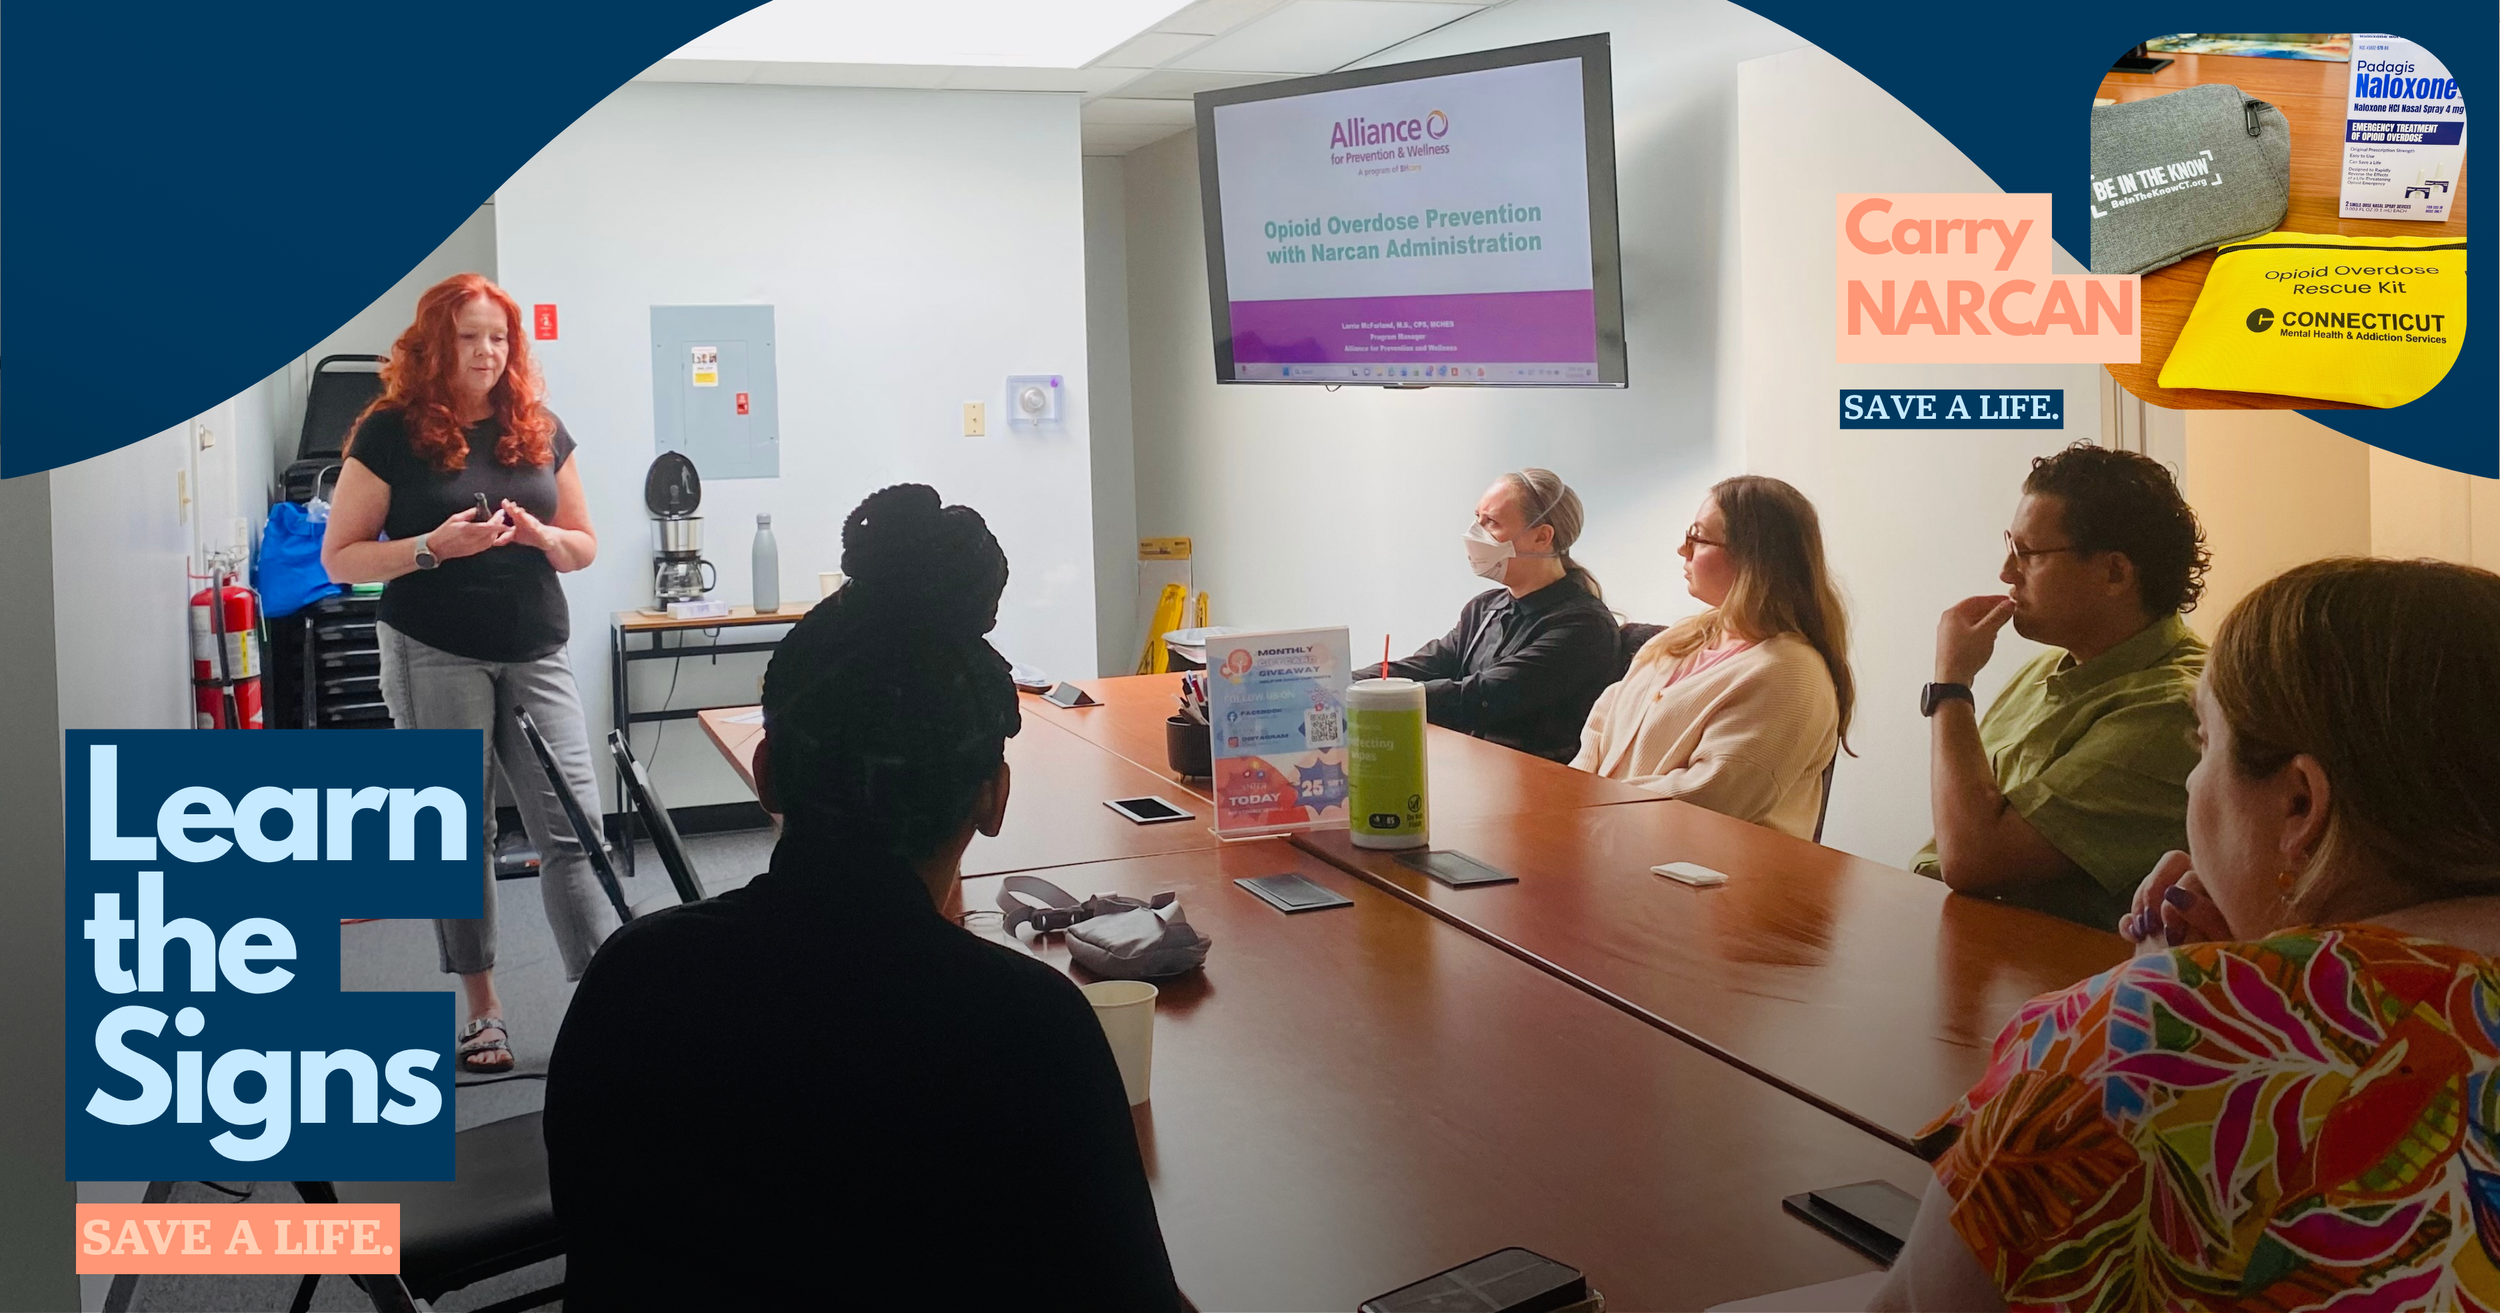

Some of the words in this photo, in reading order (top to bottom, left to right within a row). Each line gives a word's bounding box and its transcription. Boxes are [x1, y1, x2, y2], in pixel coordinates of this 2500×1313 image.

[2357, 60, 2415, 76] Padagis
[2355, 73, 2458, 100] Naloxone
[2354, 103, 2386, 112] Naloxone
[2401, 104, 2421, 113] Nasal
[2423, 105, 2444, 114] Spray
[2446, 105, 2451, 113] 4
[2452, 106, 2464, 114] mg
[1330, 117, 1422, 149] Alliance
[2352, 122, 2395, 132] EMERGENCY
[2396, 124, 2438, 133] TREATMENT
[2351, 132, 2360, 140] OF
[2362, 132, 2385, 142] OPIOID
[2386, 133, 2423, 142] OVERDOSE
[1330, 153, 1344, 165] for
[1346, 149, 1395, 164] Prevention
[1398, 147, 1405, 158] &
[1407, 144, 1450, 157] Wellness
[1364, 167, 1390, 177] program
[2092, 178, 2118, 201] BE
[2117, 174, 2138, 194] IN
[2136, 166, 2168, 188] THE
[2167, 158, 2209, 182] KNOW
[2110, 179, 2208, 208] BeInTheKnowCT.org
[1264, 218, 1321, 242] Opioid
[1327, 213, 1419, 235] Overdose
[1425, 203, 1542, 229] Prevention
[1267, 246, 1306, 264] with
[1312, 244, 1380, 262] Narcan
[1386, 232, 1542, 258] Administration
[2265, 266, 2328, 283] Opioid
[2334, 265, 2440, 276] Overdose
[2293, 282, 2372, 295] Rescue
[2379, 281, 2407, 294] Kit
[2282, 311, 2445, 332] CONNECTICUT
[2280, 328, 2311, 338] Mental
[2313, 330, 2344, 340] Health
[2346, 331, 2354, 340] &
[2356, 332, 2403, 342] Addiction
[2405, 334, 2447, 344] Services
[1258, 646, 1313, 656] MONTHLY
[1259, 666, 1320, 676] GIVEAWAY
[1224, 692, 1263, 703] FOLLOW
[1266, 691, 1278, 700] US
[1281, 690, 1295, 699] ON
[1242, 733, 1289, 742] INSTAGRAM
[1301, 780, 1324, 797] 25
[1228, 792, 1281, 806] TODAY
